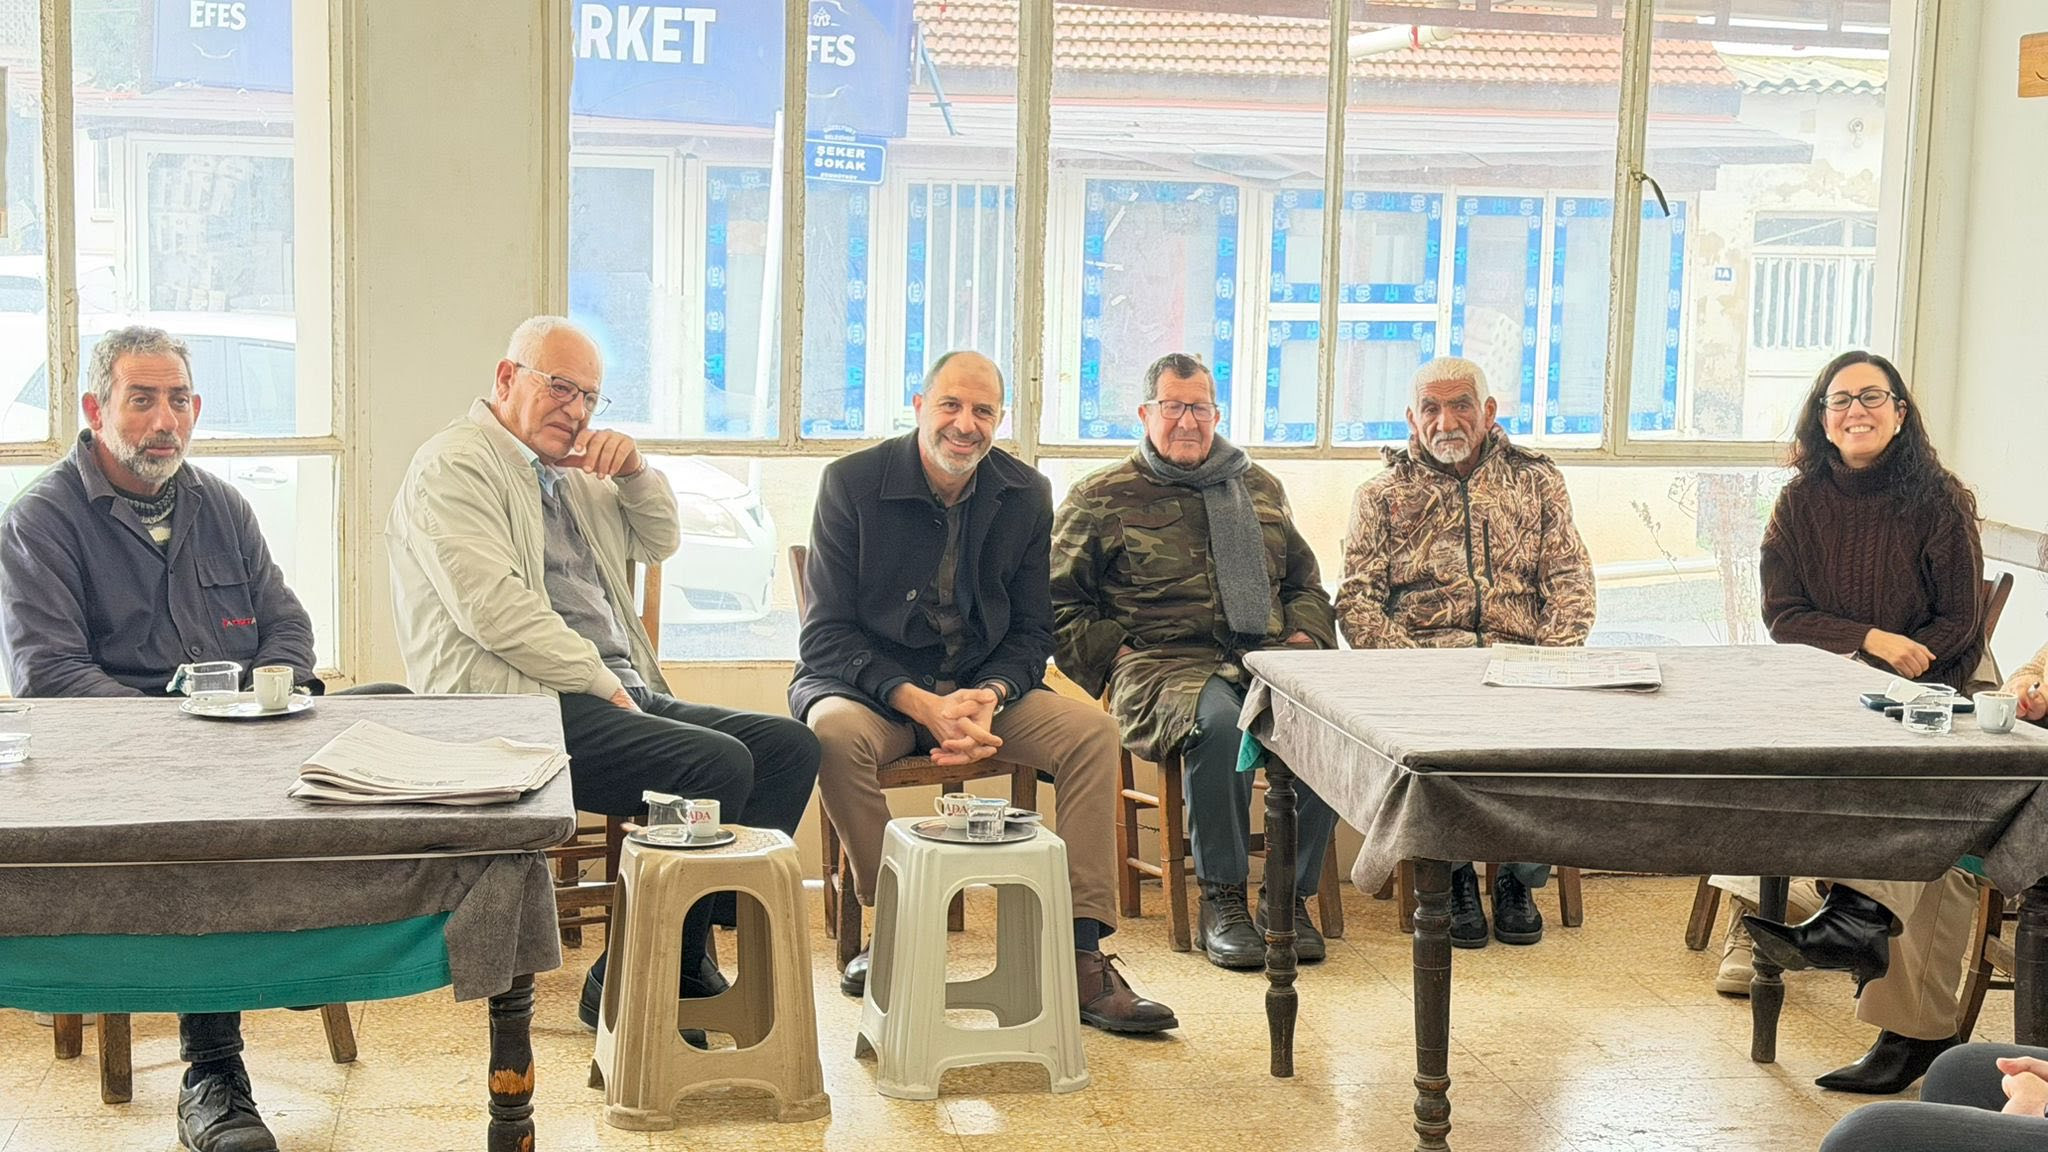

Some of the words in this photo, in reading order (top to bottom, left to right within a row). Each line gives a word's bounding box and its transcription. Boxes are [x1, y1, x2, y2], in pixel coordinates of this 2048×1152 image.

[189, 0, 246, 30] EFES
[572, 3, 716, 65] RKET
[806, 34, 856, 67] FES
[816, 145, 866, 158] ŞEKER
[814, 157, 867, 171] SOKAK
[946, 803, 968, 814] ADA
[689, 811, 711, 821] ADA
